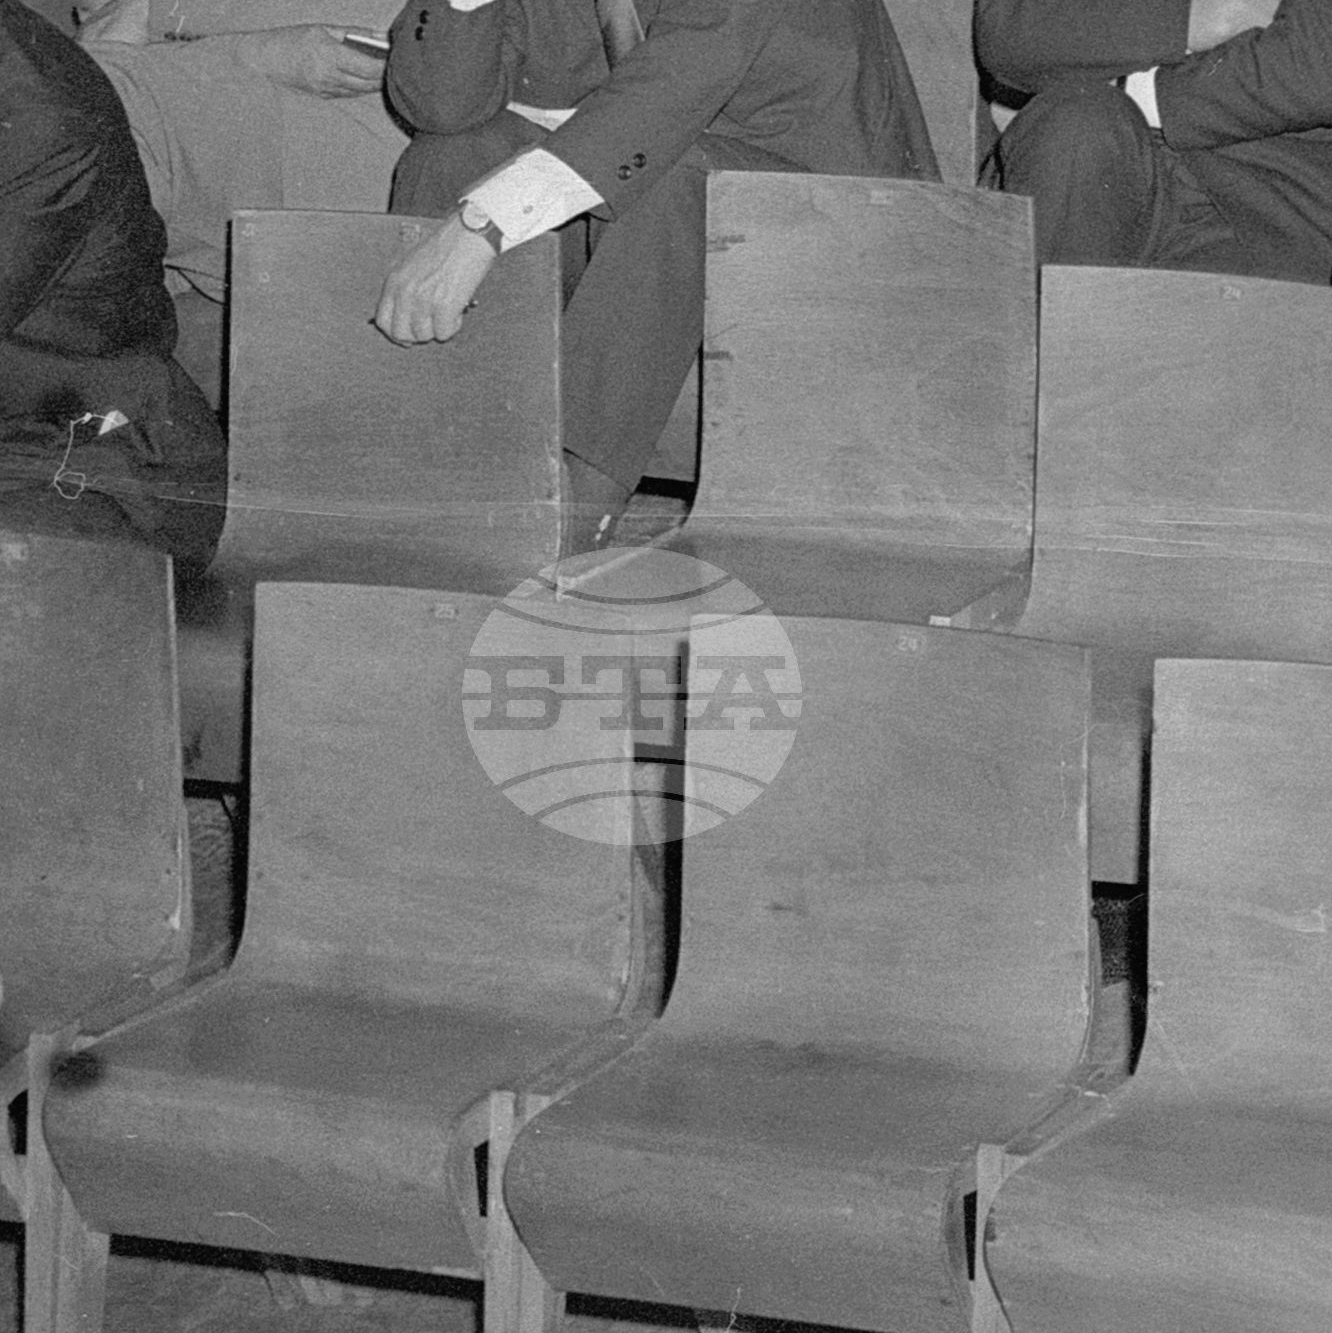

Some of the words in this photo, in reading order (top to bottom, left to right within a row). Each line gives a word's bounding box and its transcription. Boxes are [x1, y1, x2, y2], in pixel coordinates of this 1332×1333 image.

[1222, 284, 1243, 300] 24
[434, 602, 456, 620] 25
[898, 634, 919, 652] 24
